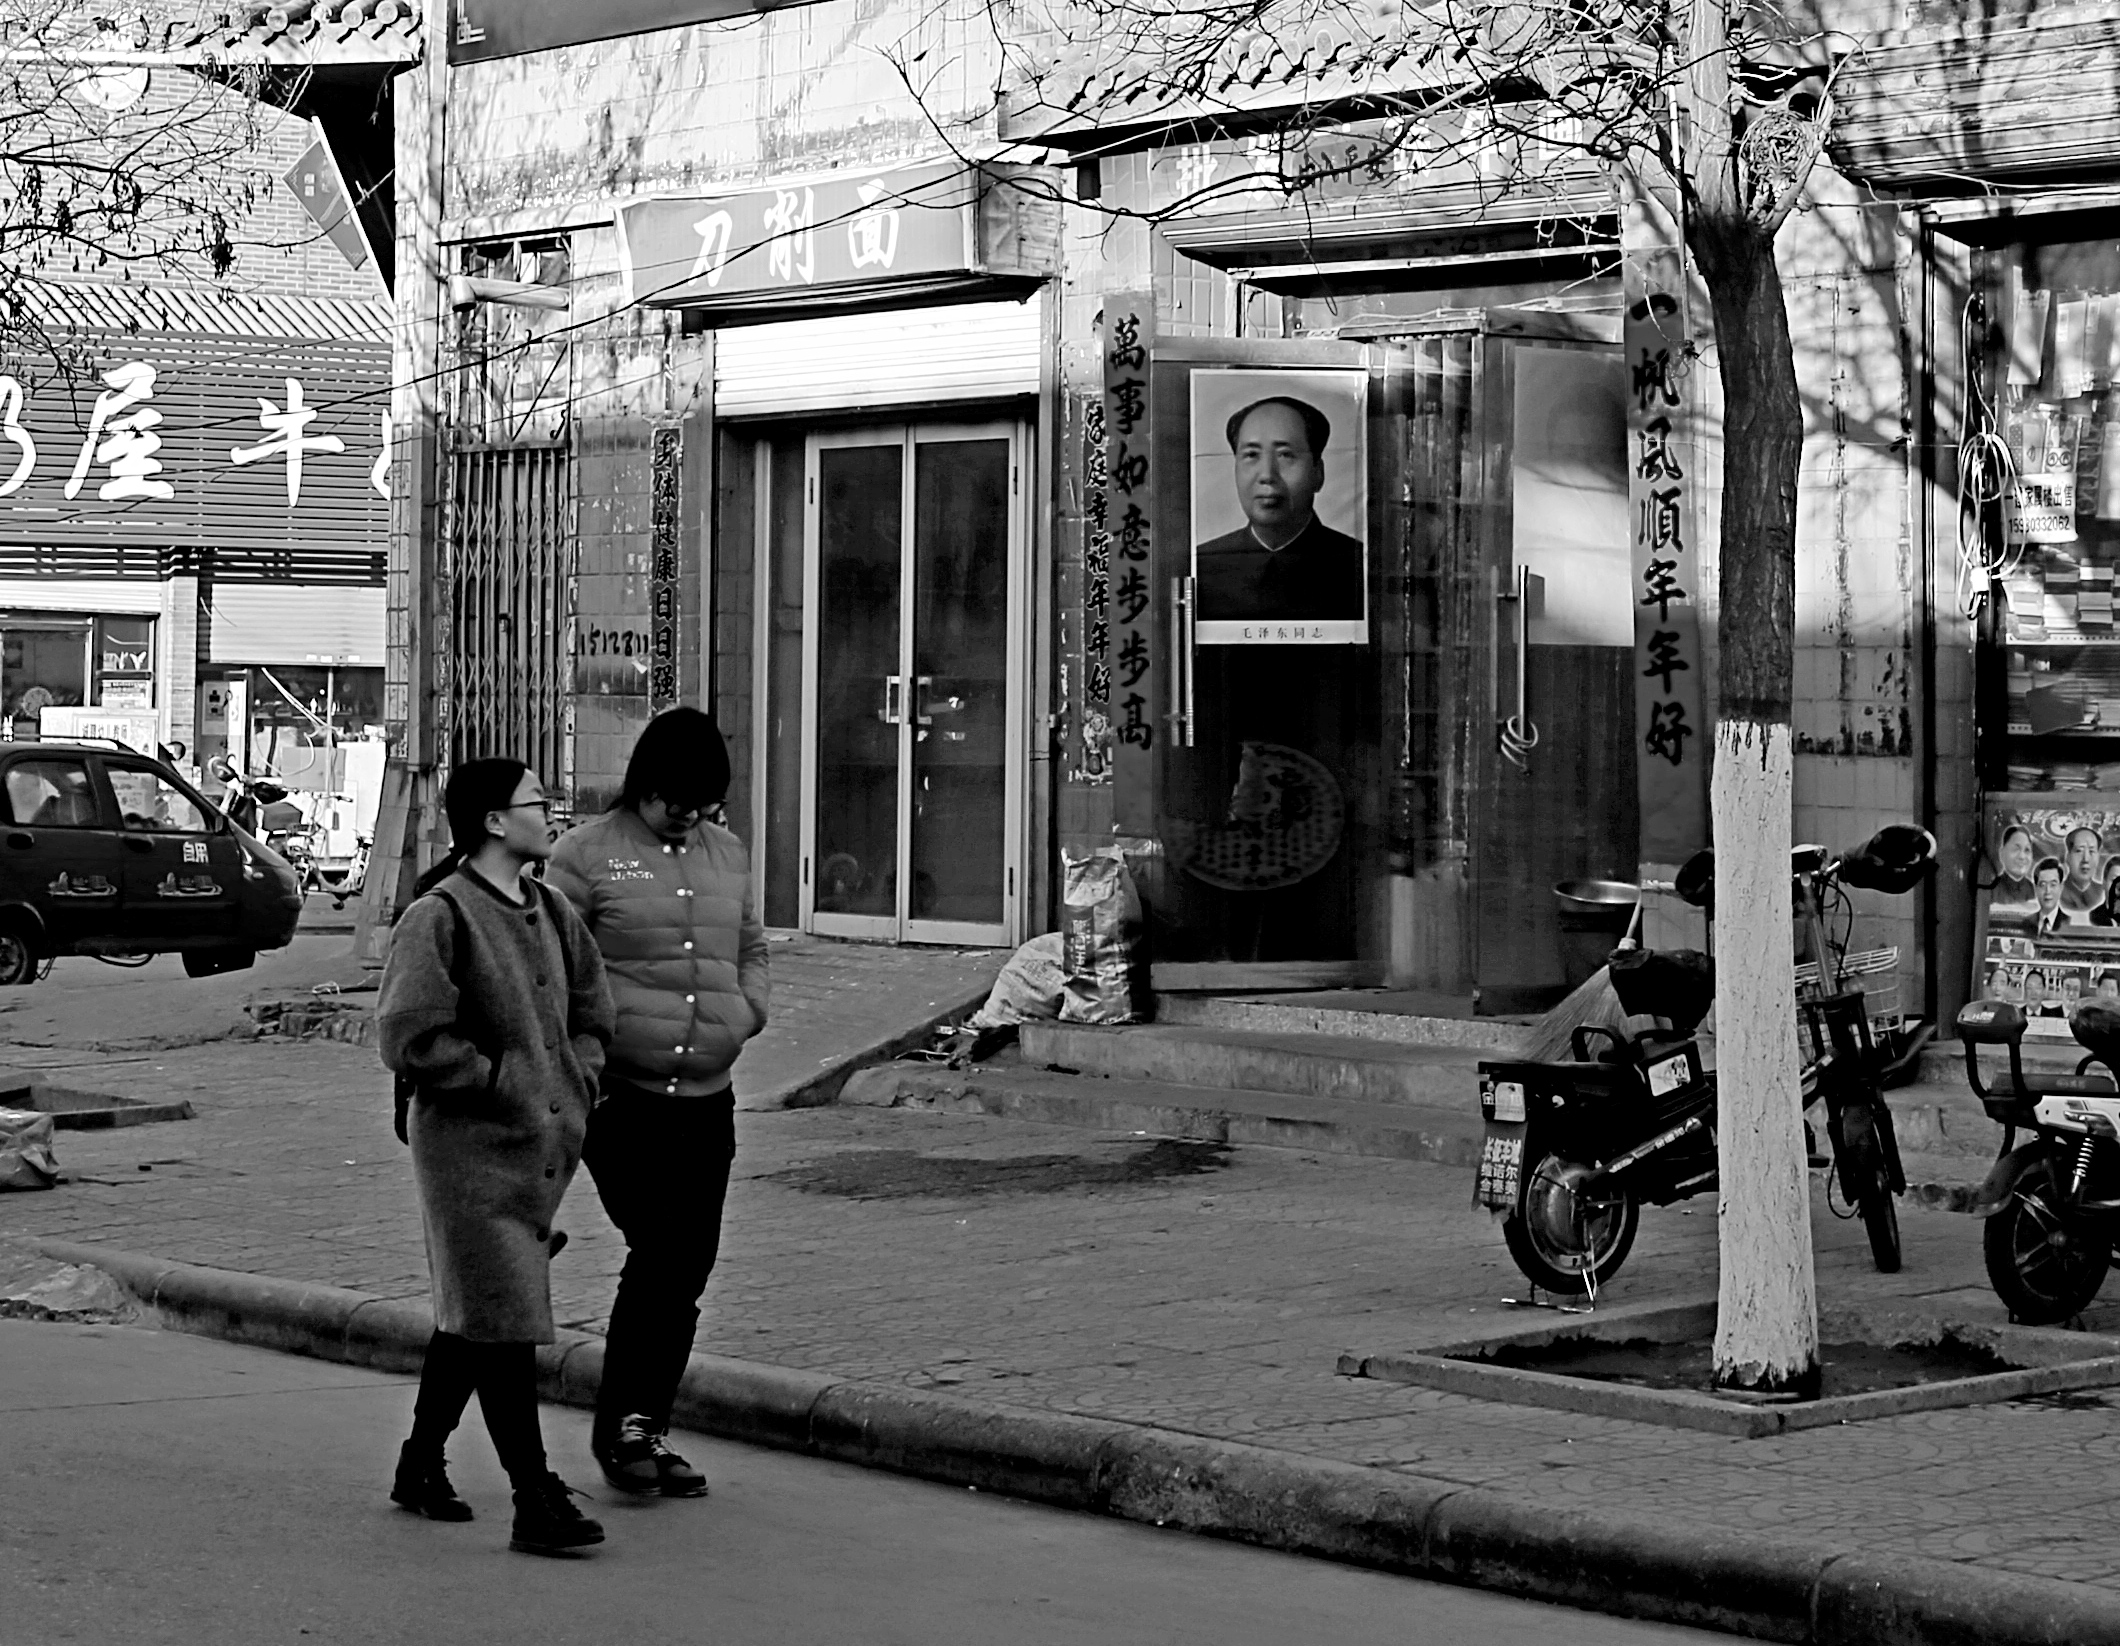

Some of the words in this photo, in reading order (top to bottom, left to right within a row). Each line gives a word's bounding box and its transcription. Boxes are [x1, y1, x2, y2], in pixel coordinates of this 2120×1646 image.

[688, 178, 899, 288] 刀削面
[653, 432, 677, 699] 身体健康日日强
[1242, 626, 1324, 640] 毛泽东同志
